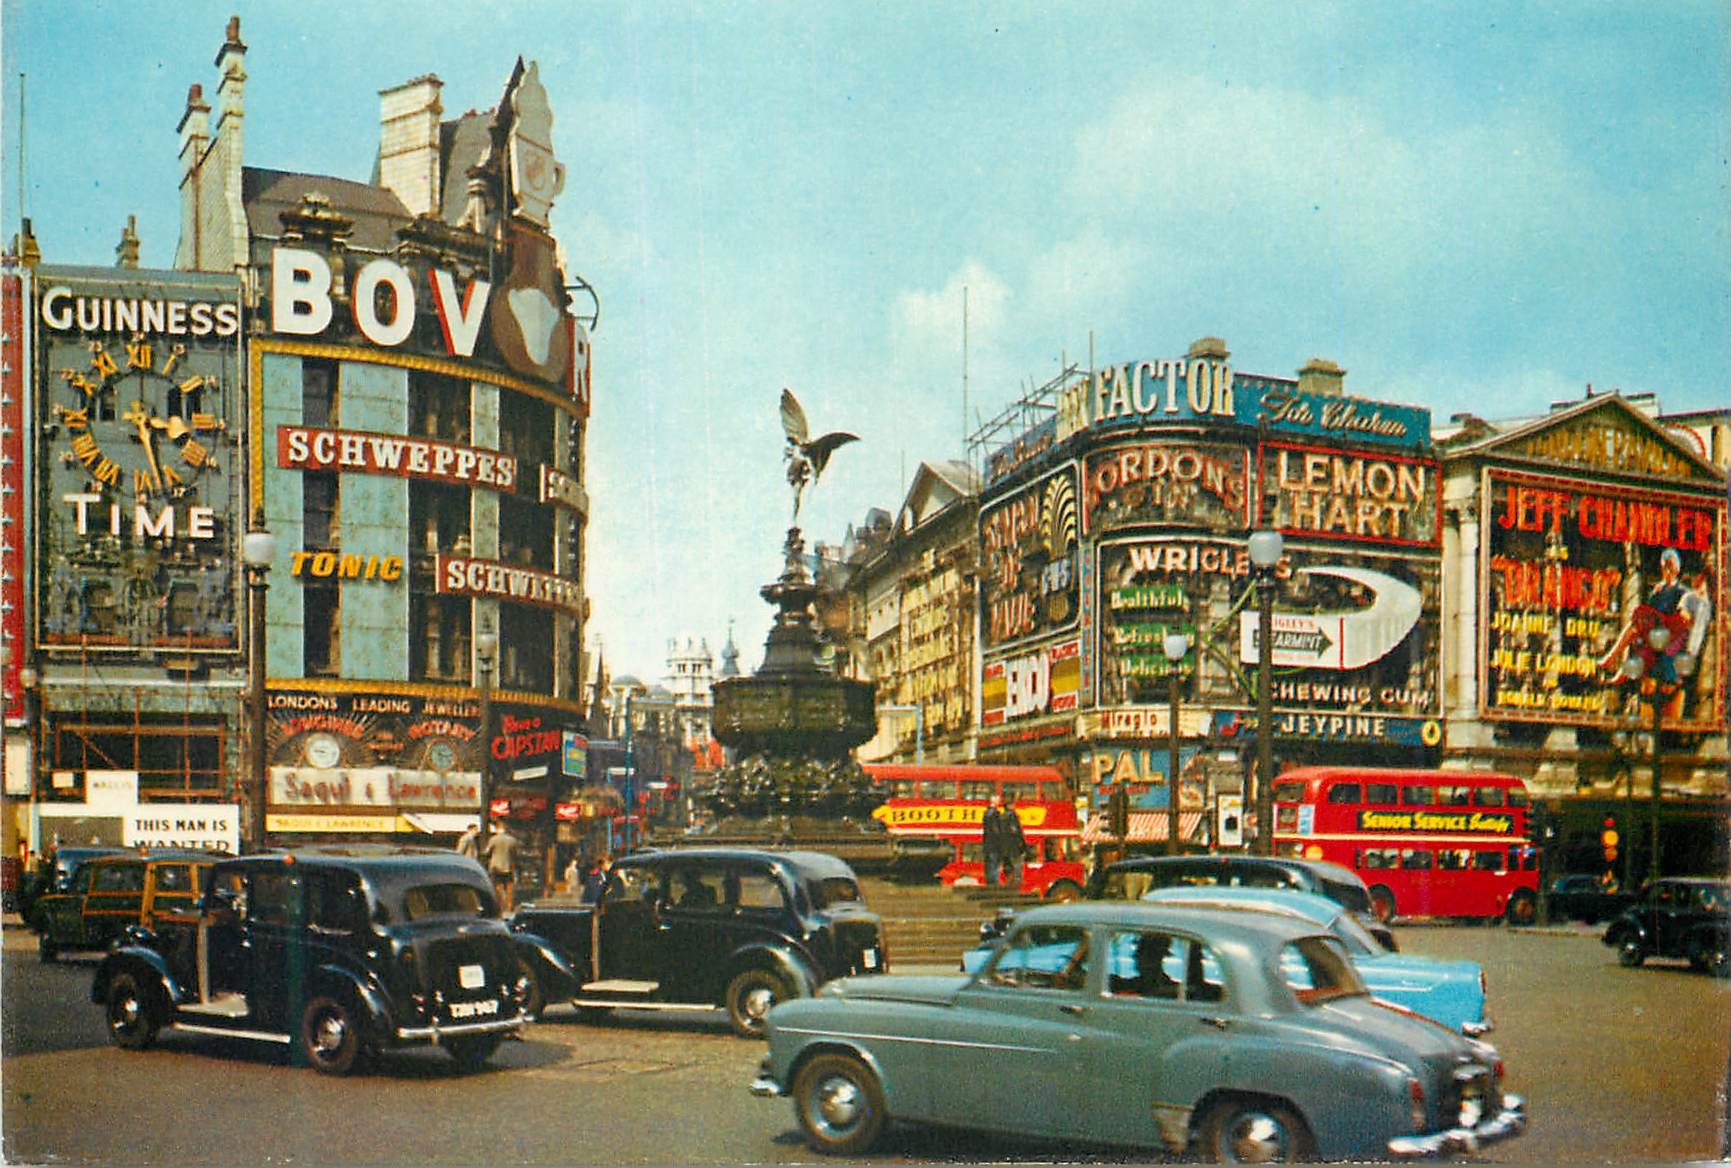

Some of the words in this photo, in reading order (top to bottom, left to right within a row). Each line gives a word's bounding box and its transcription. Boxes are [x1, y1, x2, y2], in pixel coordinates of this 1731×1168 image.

[41, 286, 238, 336] GUINNESS
[1093, 357, 1236, 422] FACTOR
[287, 430, 513, 487] SCHWEPPES
[1277, 450, 1425, 505] LEMON
[63, 493, 215, 538] TIME
[1293, 490, 1409, 537] HART
[1498, 486, 1571, 533] JEFF
[1578, 495, 1713, 551] CHANDLER
[290, 551, 404, 581] TONIC
[352, 698, 410, 714] LEADING
[1282, 714, 1385, 737] JEYPINE
[491, 729, 560, 760] CAPSTAN
[1092, 749, 1166, 784] PAL
[136, 819, 170, 832] THIS
[176, 819, 207, 832] MAN
[213, 819, 228, 832] IS
